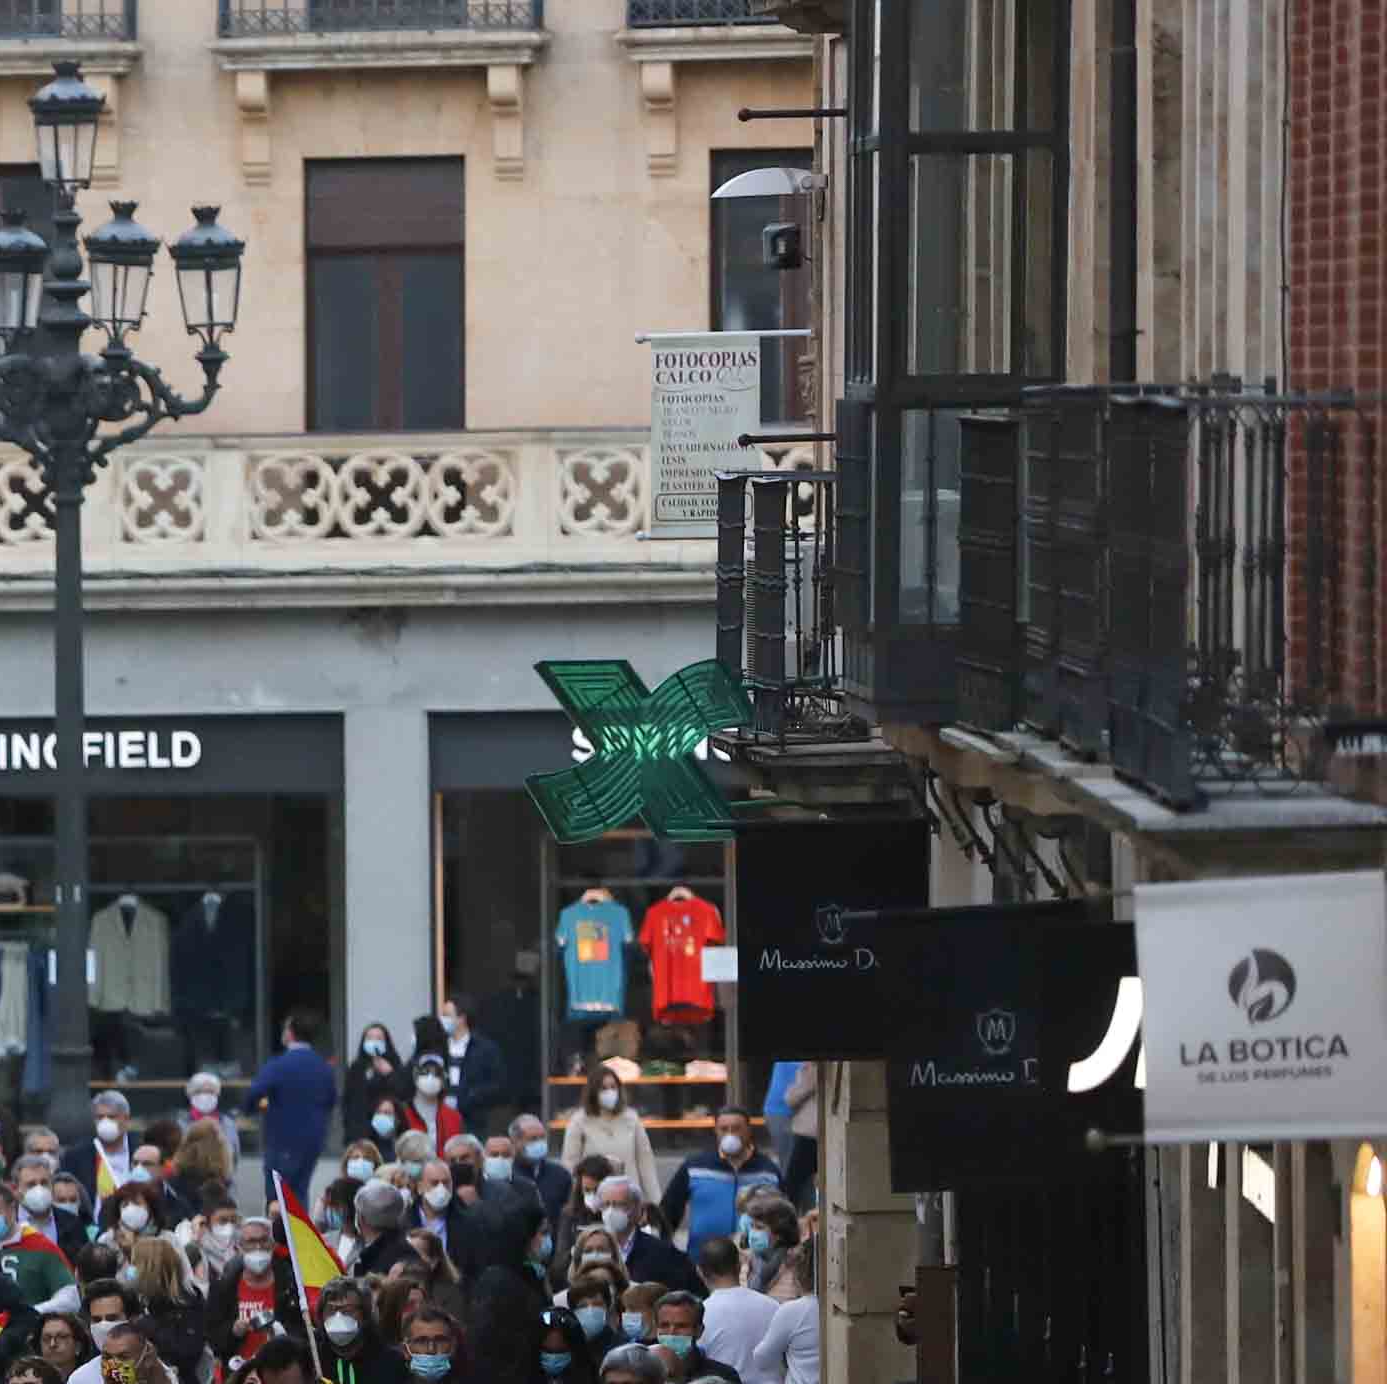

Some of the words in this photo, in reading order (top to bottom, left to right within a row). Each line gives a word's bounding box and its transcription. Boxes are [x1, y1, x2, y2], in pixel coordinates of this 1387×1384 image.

[655, 351, 758, 369] FOTOCOPIAS
[655, 369, 712, 385] CALCO
[661, 394, 725, 405] FOTOCOPIAS
[759, 948, 849, 972] Massimo
[1179, 1042, 1219, 1067] LA
[1228, 1033, 1350, 1063] BOTICA
[910, 1060, 1016, 1087] Massimo
[1220, 1068, 1249, 1083] LOS
